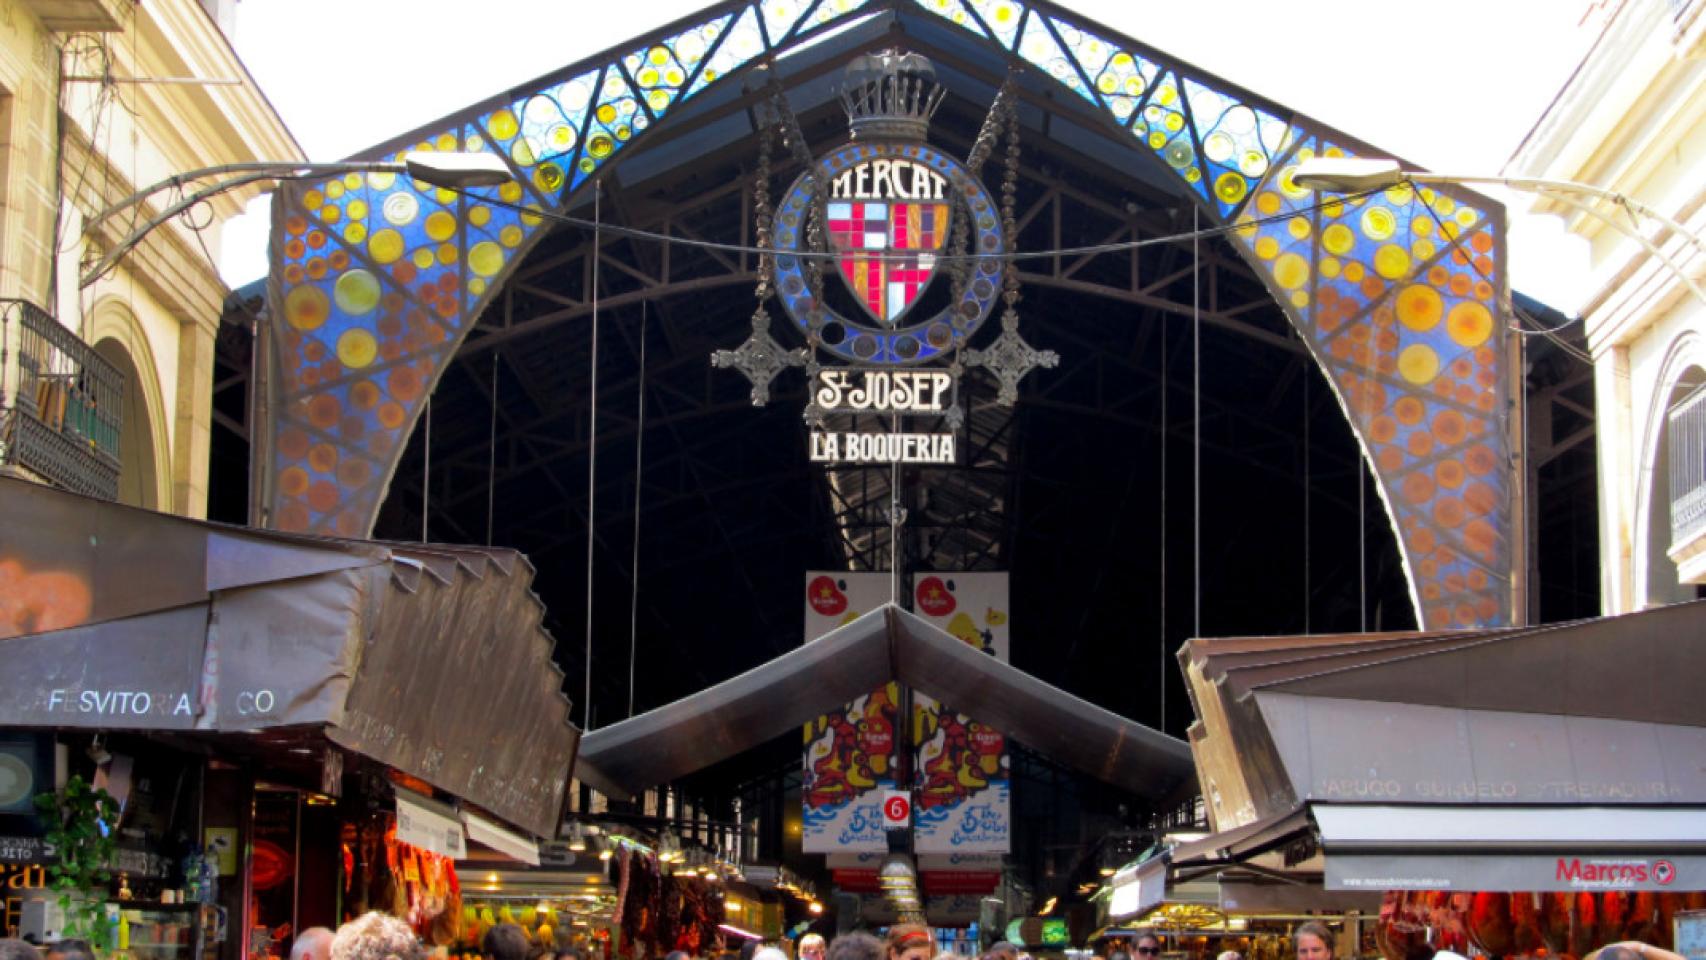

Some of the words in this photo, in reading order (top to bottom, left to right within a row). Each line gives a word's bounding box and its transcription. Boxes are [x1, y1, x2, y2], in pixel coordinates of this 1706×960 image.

[832, 159, 947, 199] MERCAT
[849, 371, 951, 410] JOSEP
[811, 433, 839, 461] LA
[845, 433, 955, 463] BOQUERIA
[891, 800, 903, 817] 6
[1556, 857, 1648, 882] Marcos
